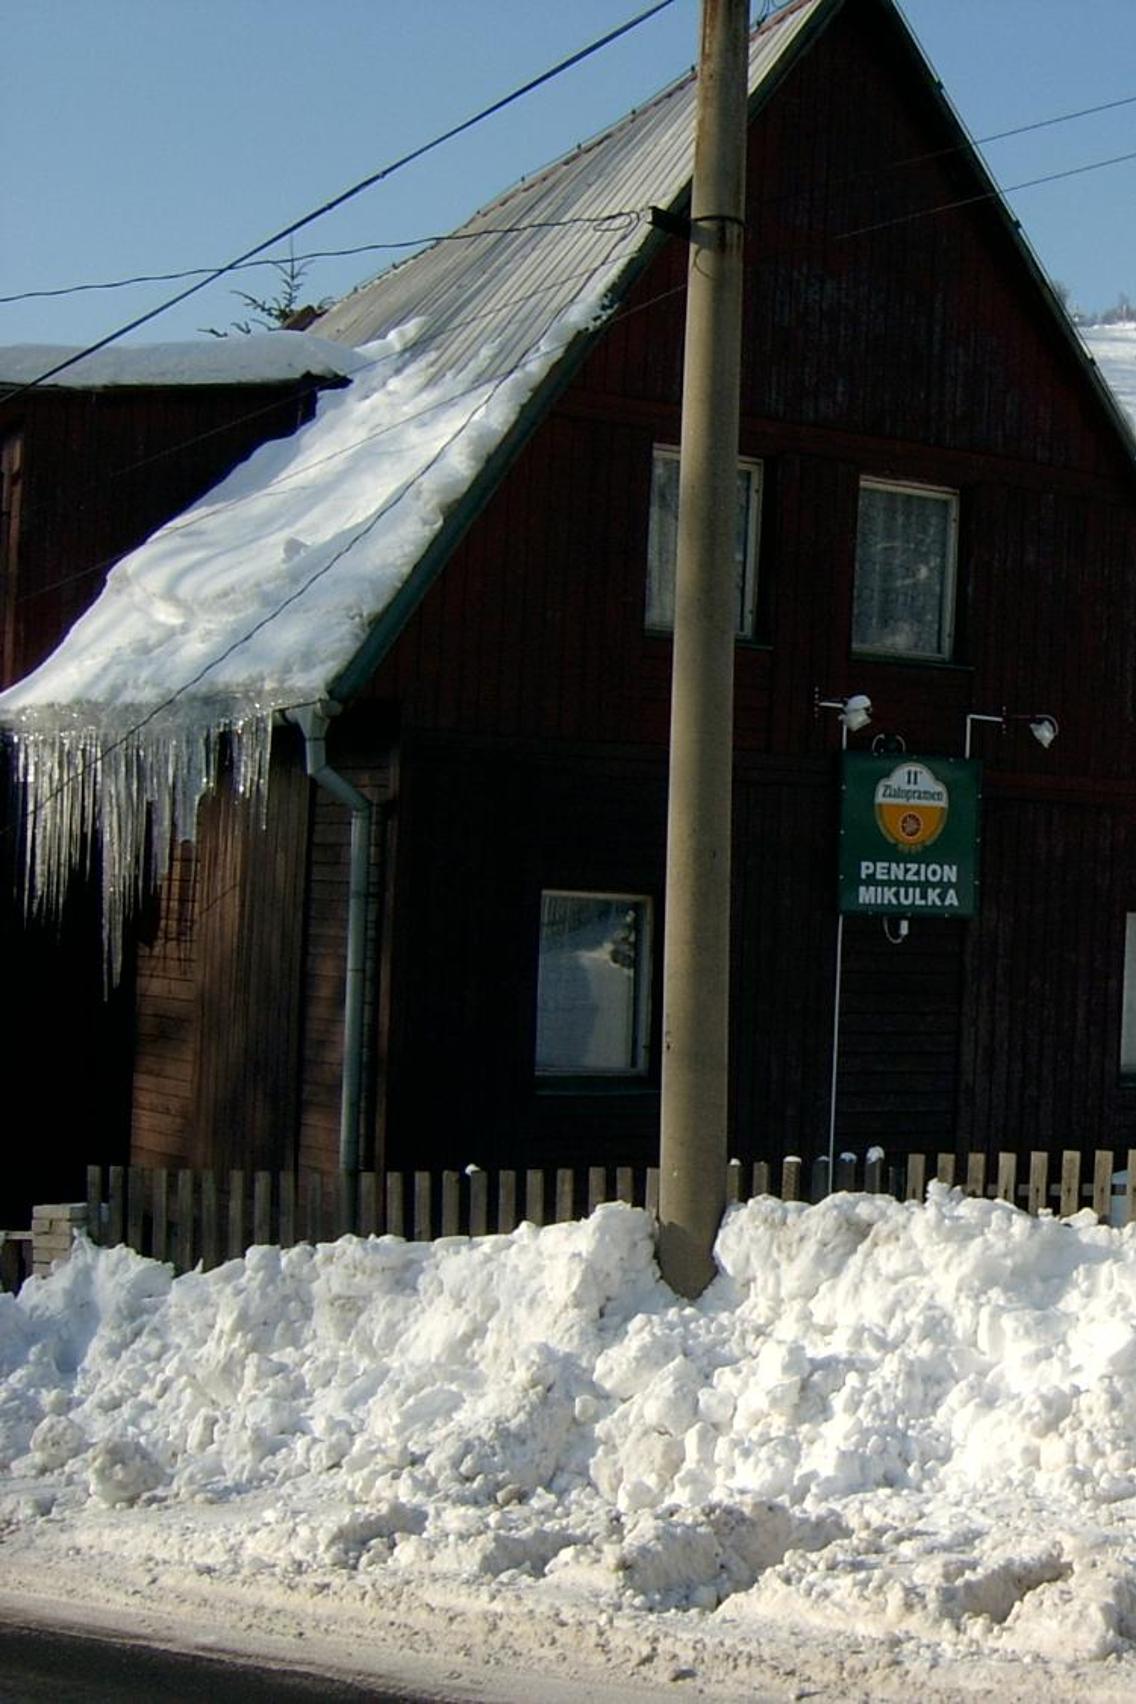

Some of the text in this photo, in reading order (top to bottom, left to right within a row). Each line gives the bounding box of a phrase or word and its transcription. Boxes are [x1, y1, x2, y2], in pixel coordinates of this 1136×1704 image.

[882, 784, 944, 802] Zlatopramen
[860, 861, 958, 883] PENZION
[858, 885, 959, 906] MIKULKA
